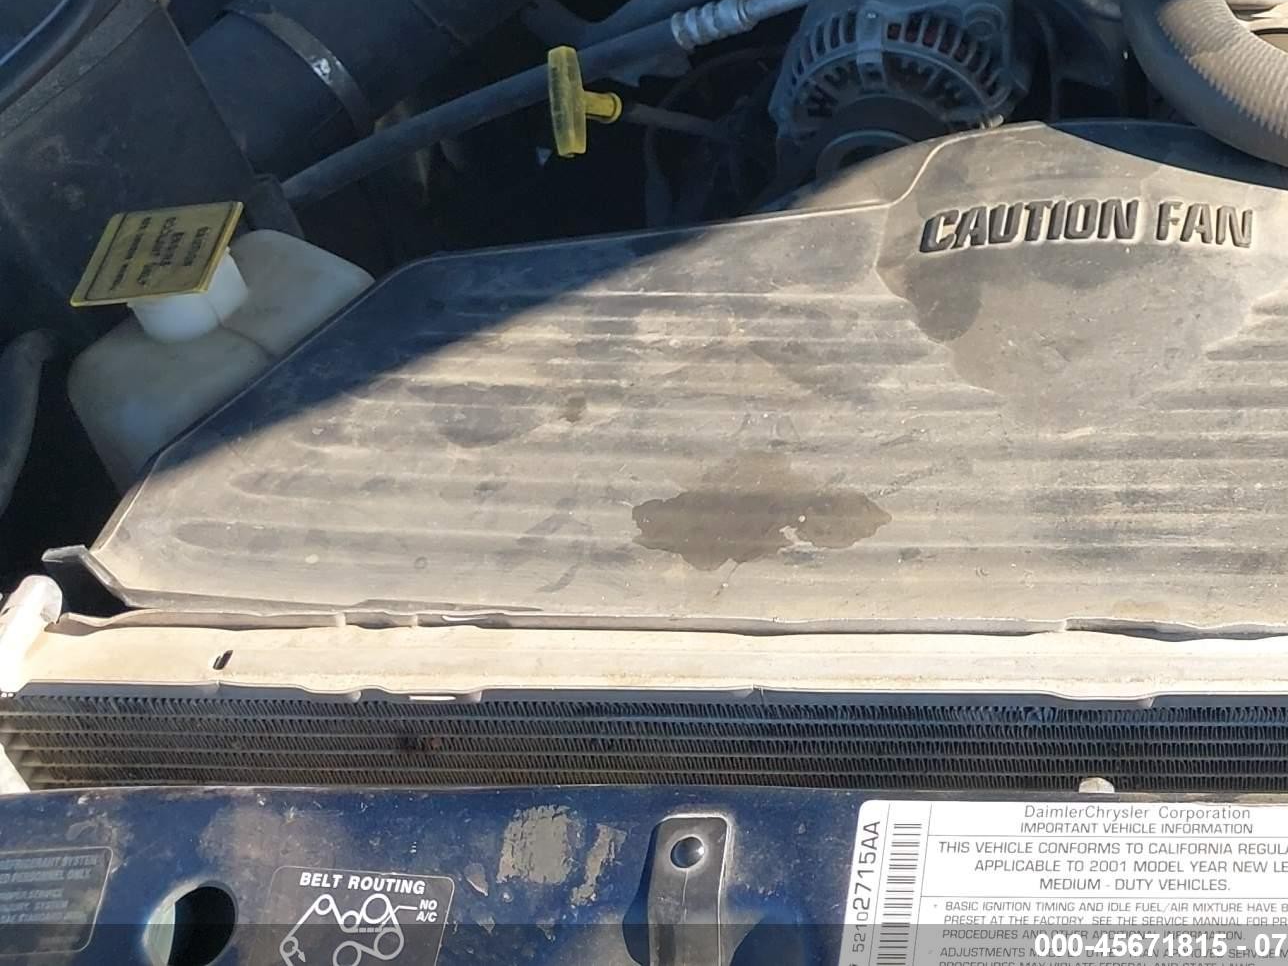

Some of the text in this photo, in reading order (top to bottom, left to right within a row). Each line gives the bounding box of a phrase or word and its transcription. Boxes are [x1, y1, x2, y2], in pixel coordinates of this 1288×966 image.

[919, 198, 1254, 253] CAUTION FAN
[1024, 805, 1251, 822] DaimlerChrysler Corporation
[1020, 822, 1253, 834] IMPORTANT VEHICLE INFORMATION
[939, 841, 970, 853] THIS
[976, 842, 1033, 854] VEHICLE
[1038, 842, 1120, 854] CONFORMS
[1126, 843, 1144, 854] TO
[1148, 843, 1233, 855] CALIFORNIA
[974, 860, 1061, 872] APPLICABLE
[1067, 860, 1084, 872] TO
[1089, 860, 1128, 872] 2001
[1133, 861, 1184, 873] MODEL
[1189, 861, 1228, 873] YEAR
[1232, 861, 1269, 873] NEW
[300, 872, 426, 894] BELT ROUTING
[852, 821, 880, 953] 52102715AA
[1039, 878, 1101, 890] MEDIUM
[1115, 879, 1153, 891] DUTY
[1158, 879, 1231, 891] VEHICLES.
[419, 899, 438, 910] NO
[945, 901, 978, 911] BASIC
[983, 901, 1031, 911] IGNITION
[1035, 902, 1075, 912] TIMING
[1079, 902, 1104, 912] AND
[1107, 902, 1131, 912] IDLE
[1135, 902, 1189, 912] FUEL/AIR
[1192, 902, 1243, 912] MIXTURE
[1247, 903, 1277, 912] HAVE
[416, 912, 438, 922] A/C
[944, 915, 986, 925] PRESET
[990, 915, 1004, 925] AT
[1008, 915, 1029, 925] THE
[1092, 916, 1113, 925] SEE
[1117, 916, 1138, 925] THE
[1142, 916, 1189, 926] SERVICE
[1192, 916, 1240, 926] MANUAL
[1246, 917, 1268, 926] FOR
[942, 929, 1018, 939] PROCEDURES
[940, 947, 1026, 958] ADJUSTMENTS
